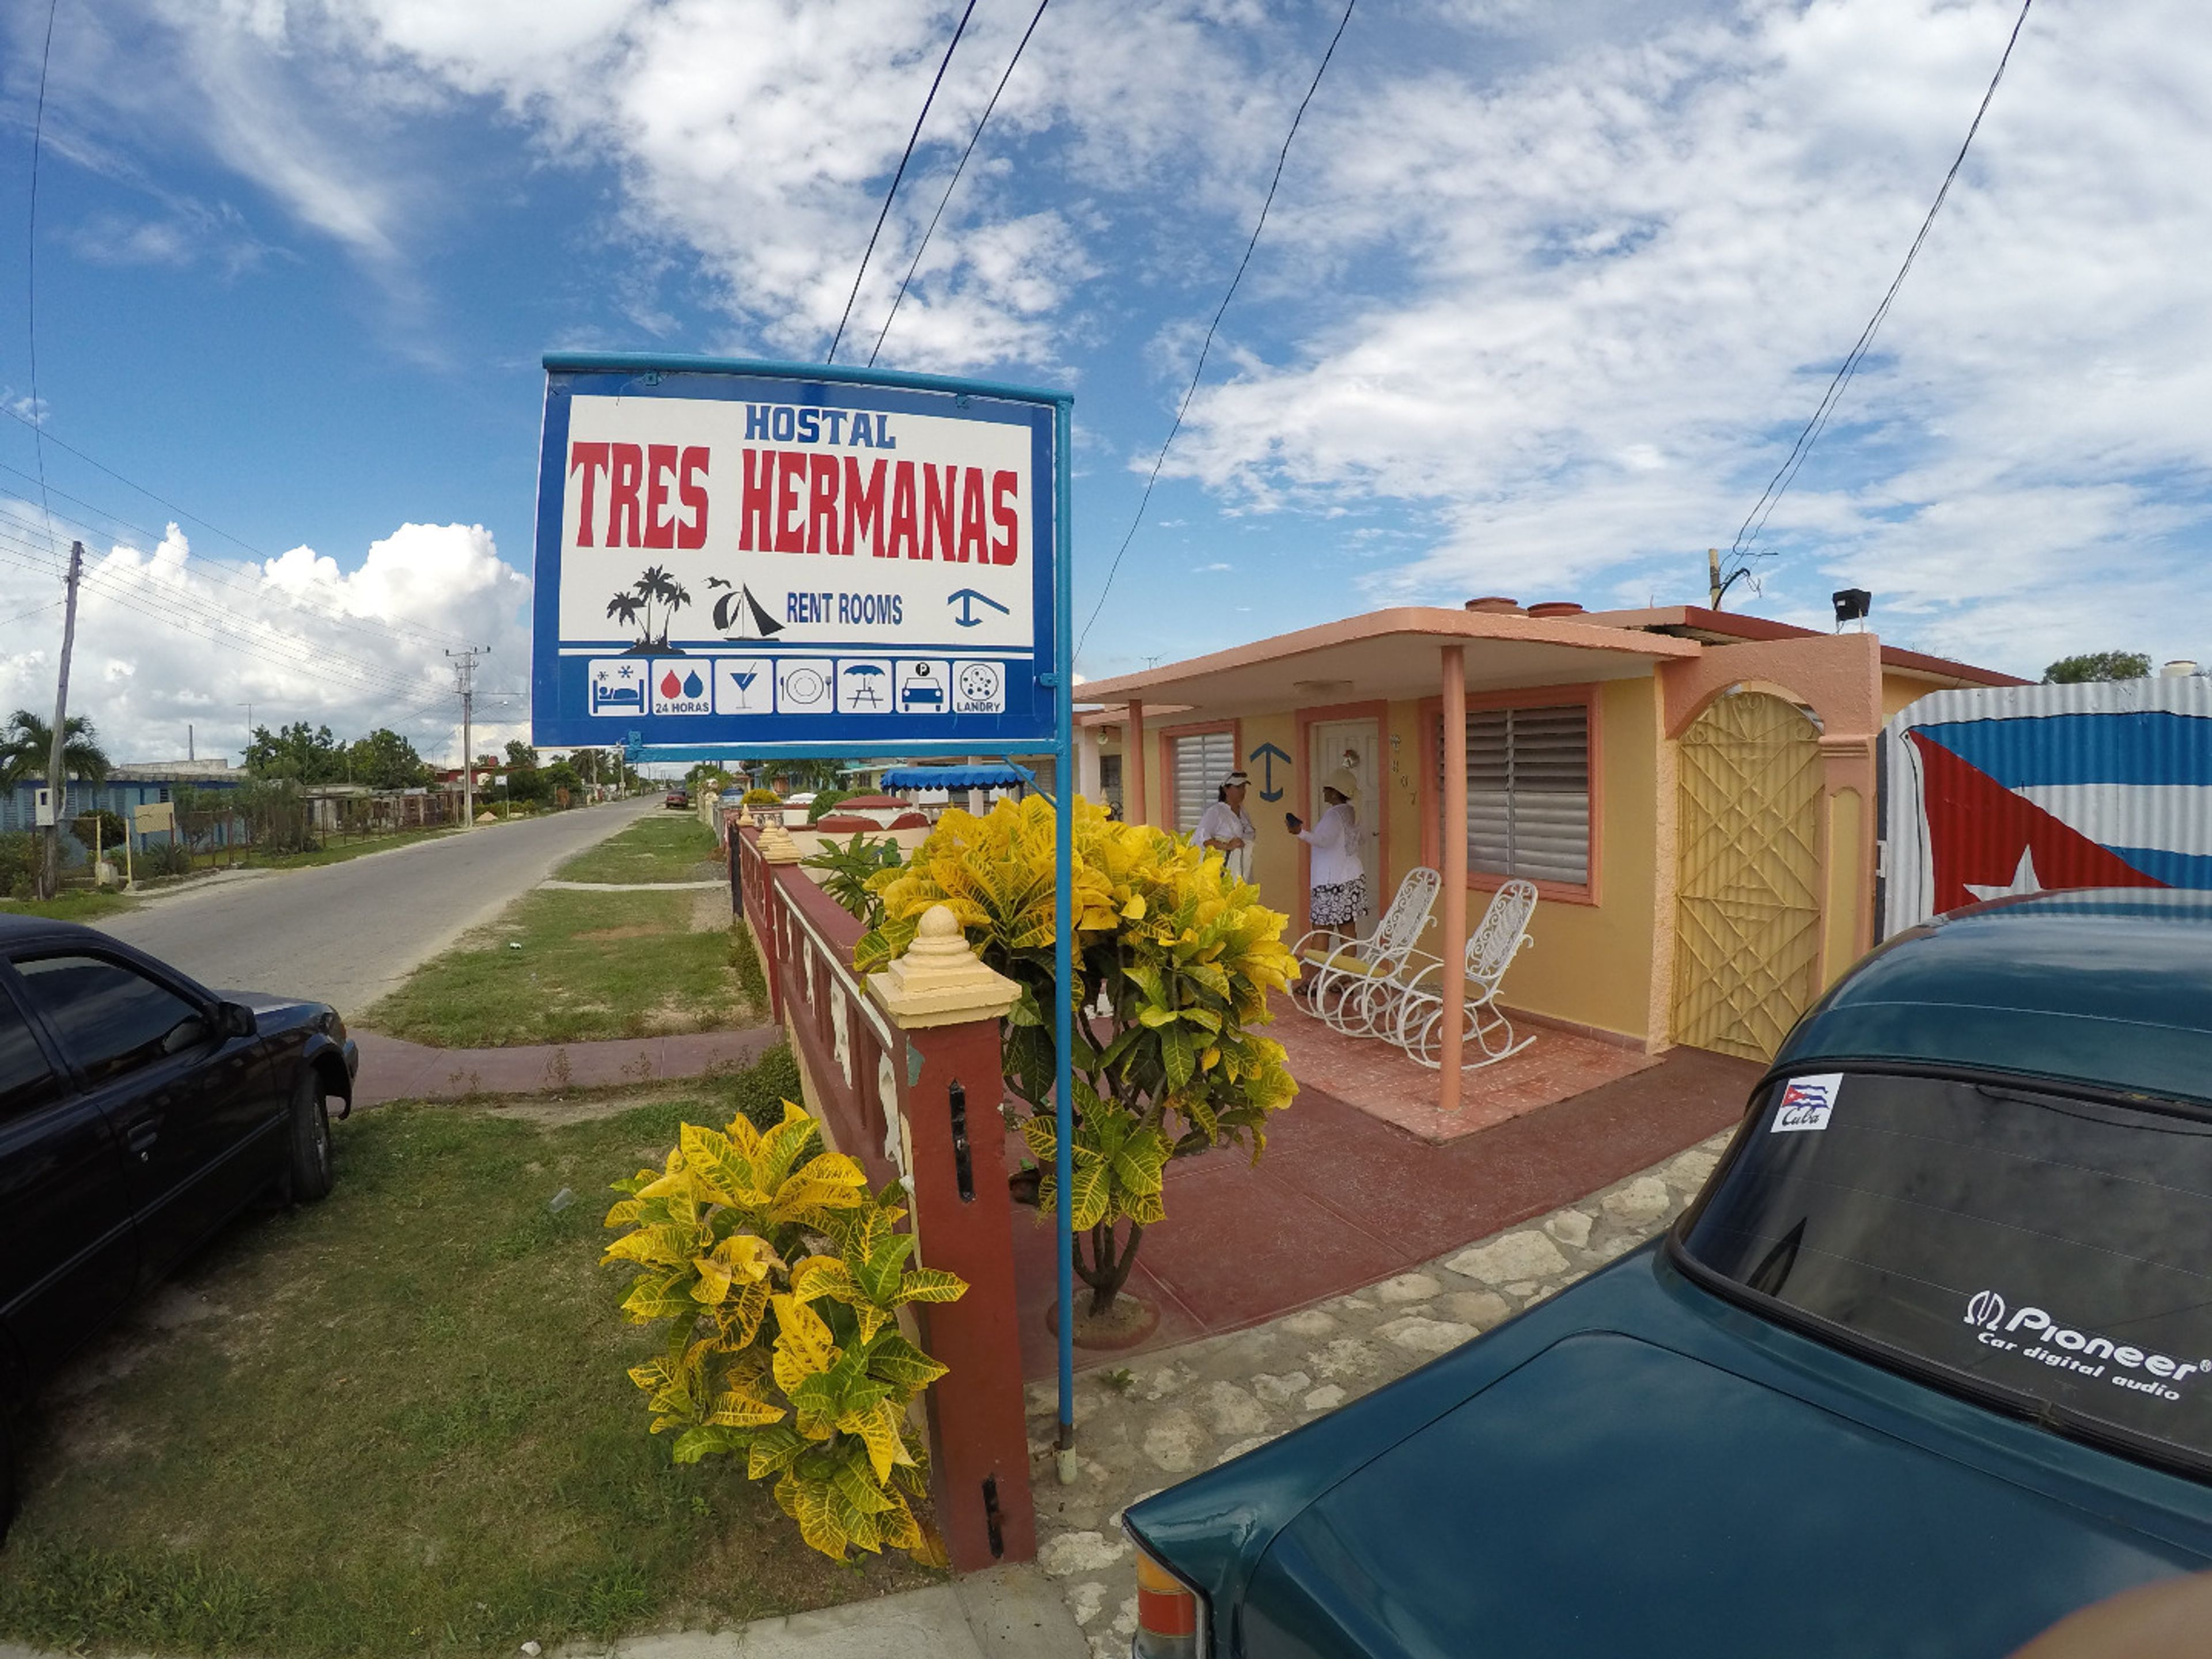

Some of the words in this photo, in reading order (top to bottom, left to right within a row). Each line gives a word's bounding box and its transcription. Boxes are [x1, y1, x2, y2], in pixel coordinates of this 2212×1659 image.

[744, 404, 896, 449] HOSTAL
[570, 441, 711, 550] TRES
[738, 449, 1018, 566] HERMANAS
[787, 592, 834, 623] RENT
[839, 593, 903, 625] ROOMS
[656, 703, 669, 713] 24
[672, 702, 709, 713] HORAS
[957, 702, 1000, 712] LANDRY
[1782, 1108, 1820, 1126] Cuba
[1978, 1332, 2018, 1350] Car
[2023, 1347, 2105, 1377] digital
[2112, 1376, 2180, 1400] audio
